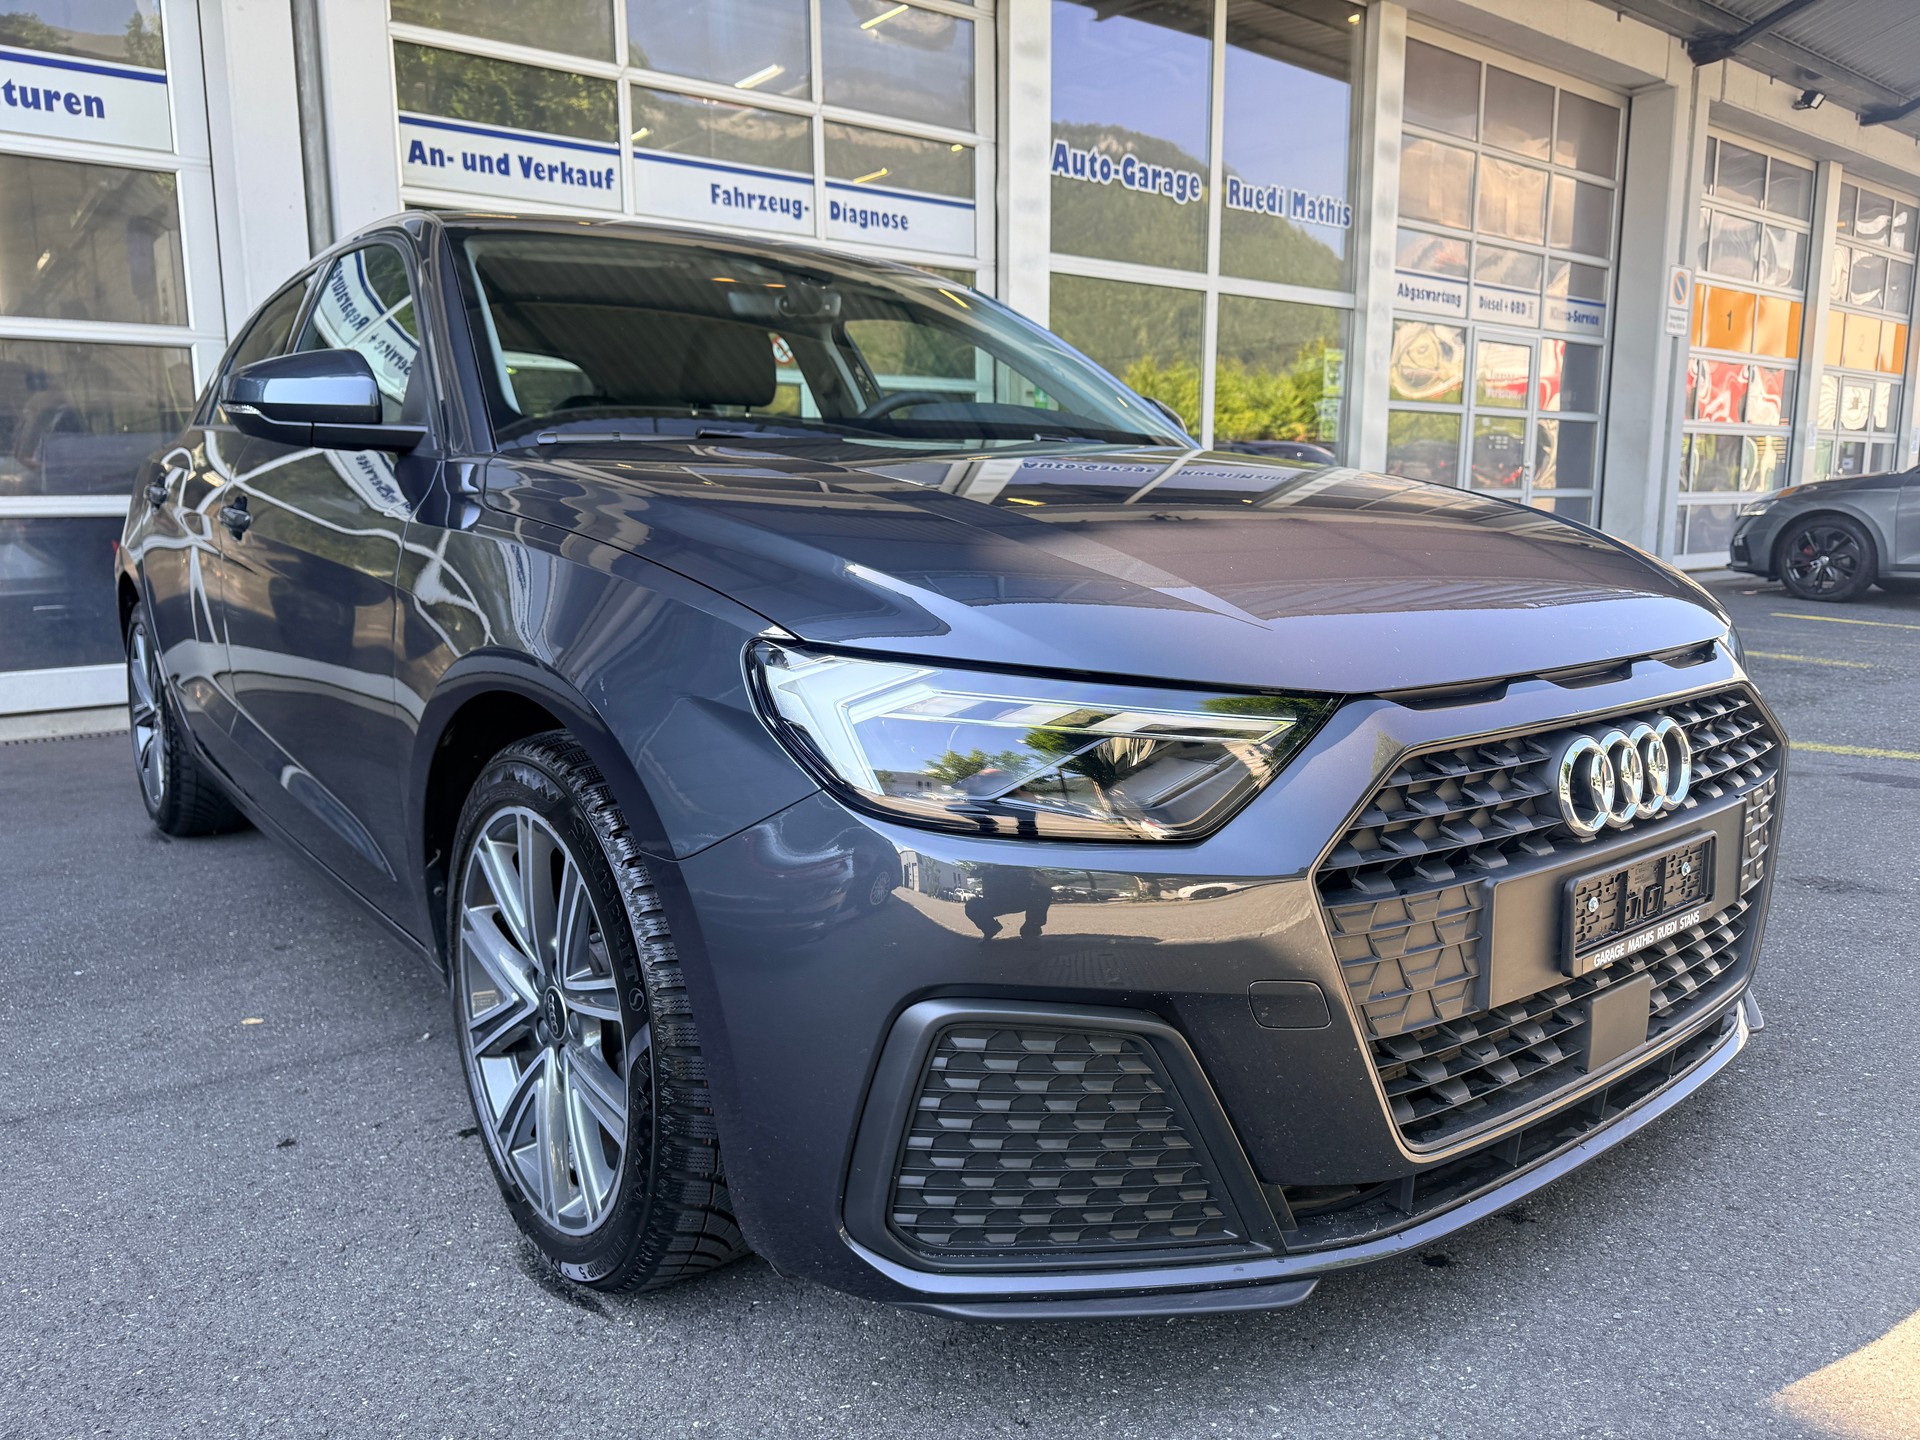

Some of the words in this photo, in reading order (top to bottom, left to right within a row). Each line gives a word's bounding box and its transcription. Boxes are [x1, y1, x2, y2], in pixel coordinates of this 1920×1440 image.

[0, 78, 105, 119] turen
[408, 139, 454, 168] An-
[462, 151, 510, 177] und
[518, 154, 615, 190] Verkauf
[1050, 141, 1202, 204] Auto-Garage
[1227, 176, 1285, 216] Ruedi
[1290, 190, 1351, 228] Mathis
[710, 183, 810, 220] Fahrzeug-
[830, 200, 910, 231] Diagnose
[1396, 282, 1462, 308] Abgaswartung
[1479, 294, 1503, 312] Diesel
[1510, 300, 1526, 316] OBD
[1726, 310, 1732, 331] 1
[1594, 943, 1625, 967] GARAGE
[1628, 930, 1655, 953] MATHIS
[1657, 921, 1677, 939] RUEDI
[1680, 910, 1700, 930] STANS
